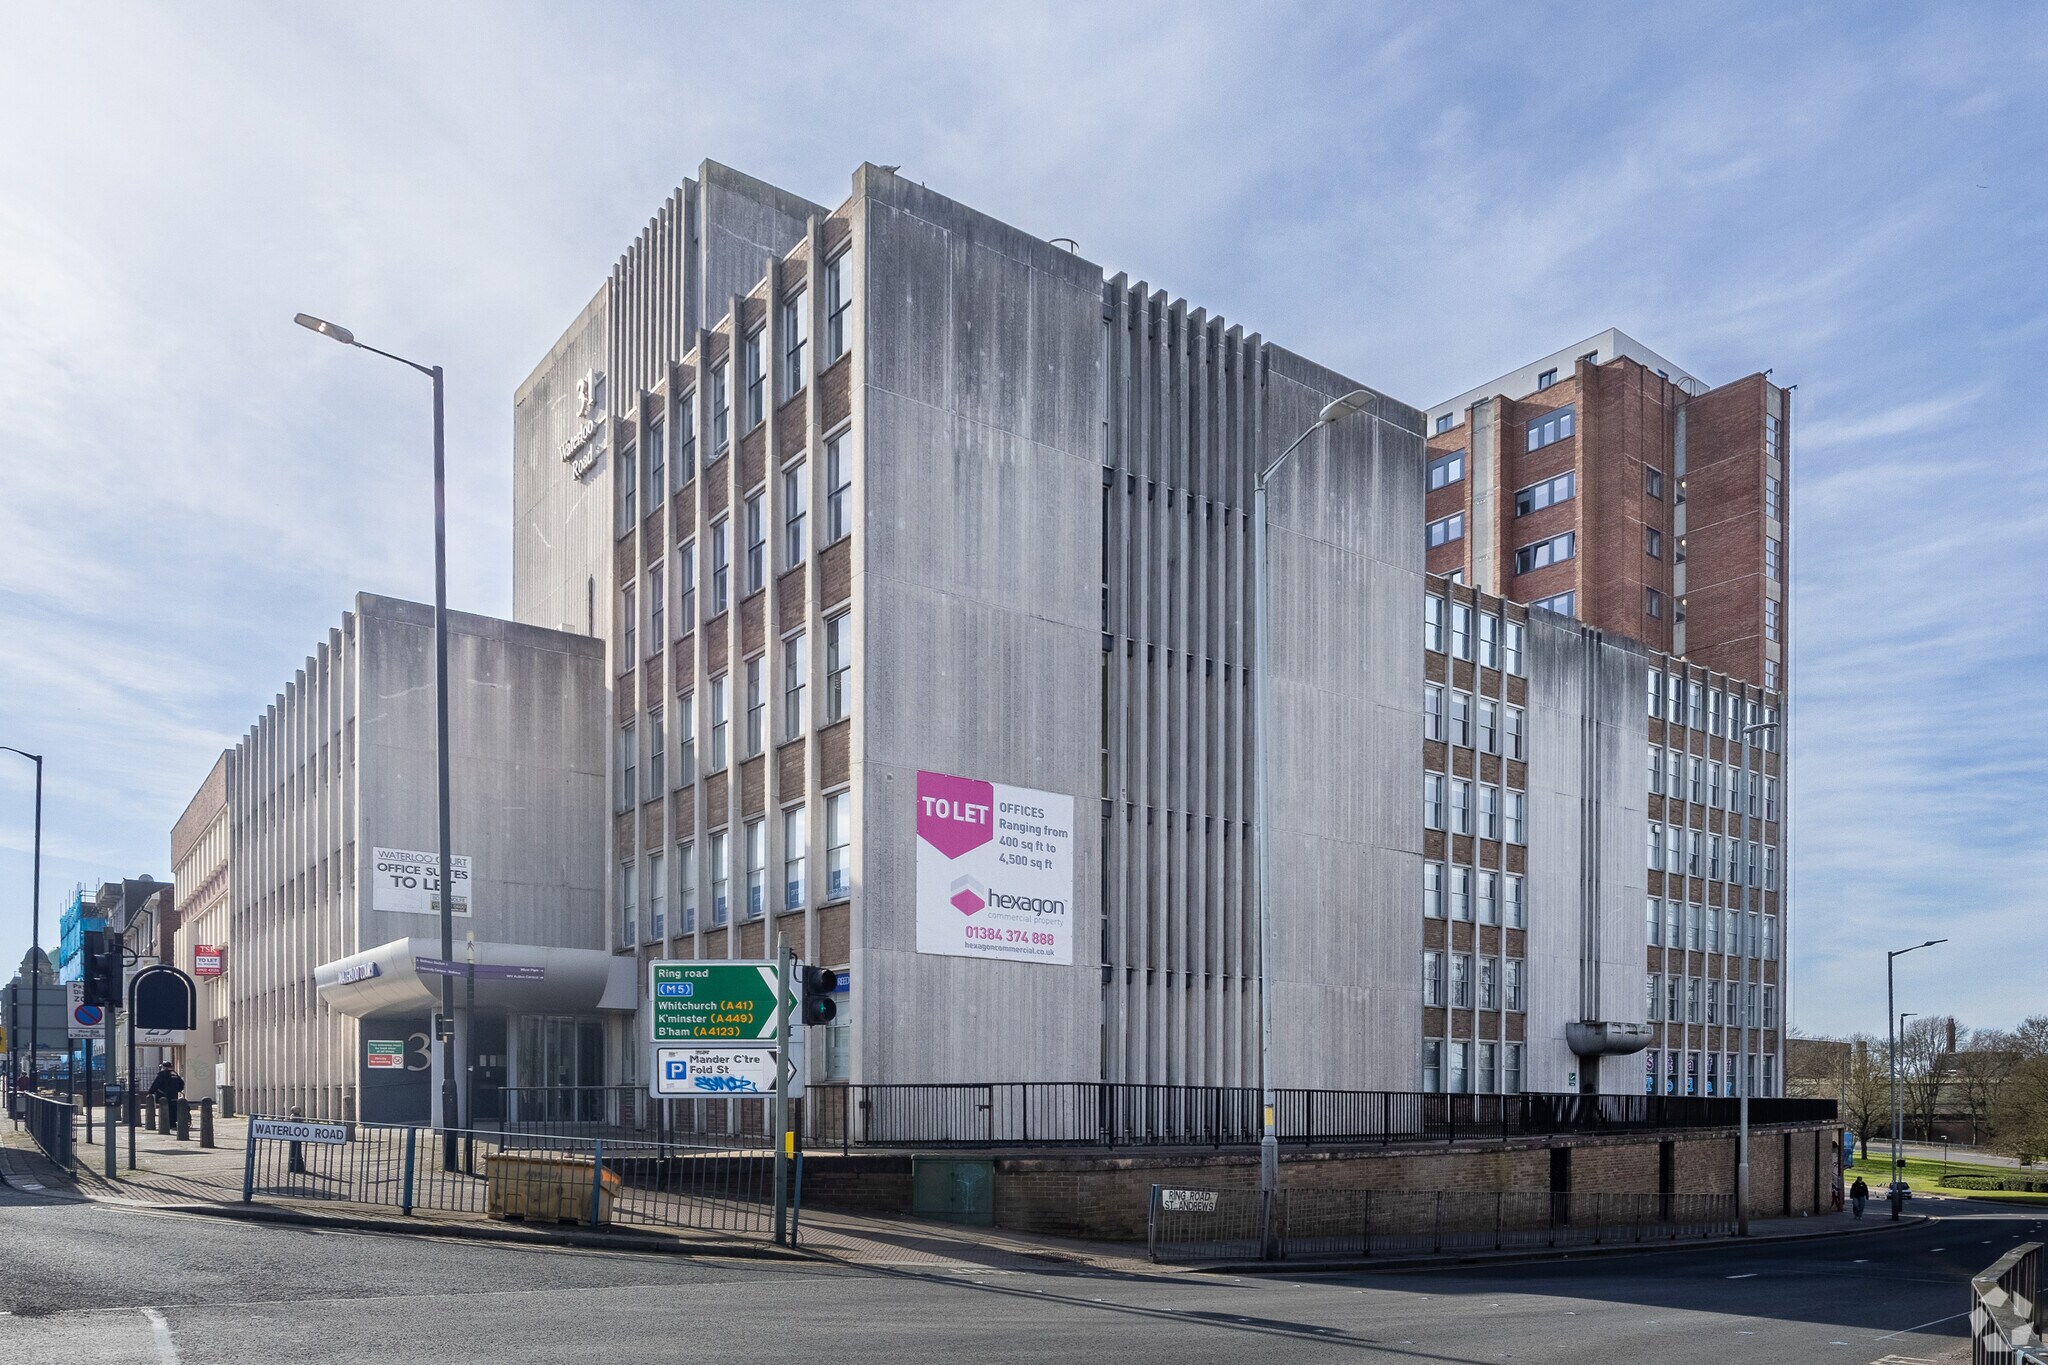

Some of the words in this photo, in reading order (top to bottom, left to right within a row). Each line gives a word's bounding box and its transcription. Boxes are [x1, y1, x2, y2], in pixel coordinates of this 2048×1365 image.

[558, 420, 594, 461] Waterloo
[572, 444, 593, 480] Road
[922, 796, 950, 819] TO
[953, 803, 989, 824] LET
[1000, 802, 1044, 818] OFFICES
[999, 819, 1042, 837] Ranging
[1044, 826, 1068, 838] from
[999, 836, 1019, 847] 400
[1021, 841, 1033, 852] sq
[1036, 841, 1044, 852] ft
[1046, 843, 1056, 853] to
[378, 850, 432, 863] WATERLOO
[999, 853, 1028, 866] 4,500
[1030, 859, 1043, 870] sq
[1045, 859, 1053, 869] ft
[377, 863, 421, 875] OFFICE
[390, 875, 417, 888] TO
[988, 888, 1064, 916] hexagon
[988, 913, 1032, 923] commercial
[1034, 916, 1063, 927] property
[966, 926, 1002, 941] 01384
[1006, 929, 1029, 943] 374
[1032, 933, 1054, 946] 888
[965, 942, 1055, 956] hexagoncommercial.co.uk
[658, 969, 681, 979] Ring
[685, 969, 709, 977] road
[660, 984, 691, 994] (M5)
[658, 1001, 717, 1010] Whitchurch
[720, 1000, 753, 1011] (A41)
[658, 1014, 707, 1023] K'minster
[710, 1013, 753, 1024] (A449)
[658, 1027, 690, 1036] B'ham
[693, 1026, 740, 1037] (A4123)
[671, 1063, 683, 1078] P
[690, 1055, 730, 1063] Mander
[734, 1055, 760, 1063] C'tre
[690, 1065, 712, 1074] Fold
[716, 1065, 730, 1074] St
[255, 1124, 310, 1137] WATERLOO
[315, 1128, 344, 1140] ROAD
[1169, 1191, 1186, 1200] RING
[1190, 1192, 1210, 1201] ROAD
[1165, 1201, 1174, 1210] ST
[1179, 1202, 1214, 1211] ANDREWS
